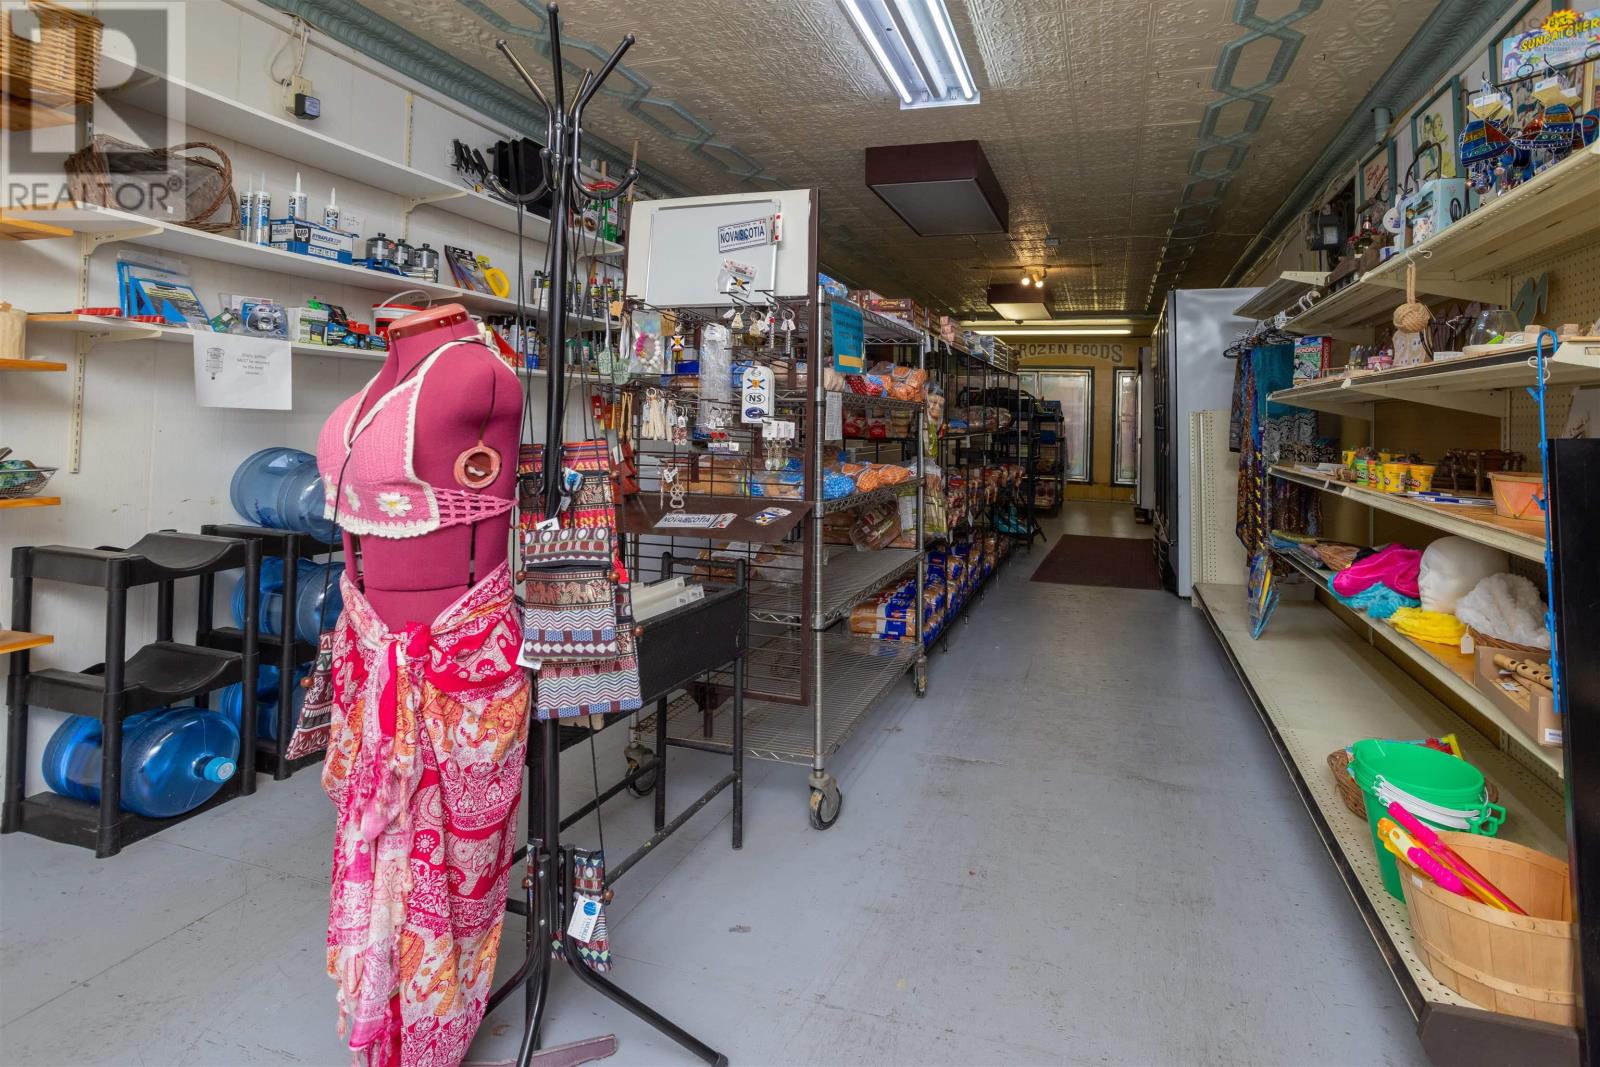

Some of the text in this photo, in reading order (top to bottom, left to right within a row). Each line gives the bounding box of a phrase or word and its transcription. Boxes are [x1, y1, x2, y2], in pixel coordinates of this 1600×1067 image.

[296, 229, 309, 237] DAP
[720, 231, 741, 244] NOVA
[739, 226, 765, 241] SCOTIA
[1073, 343, 1122, 363] FOODS
[748, 394, 762, 403] NS
